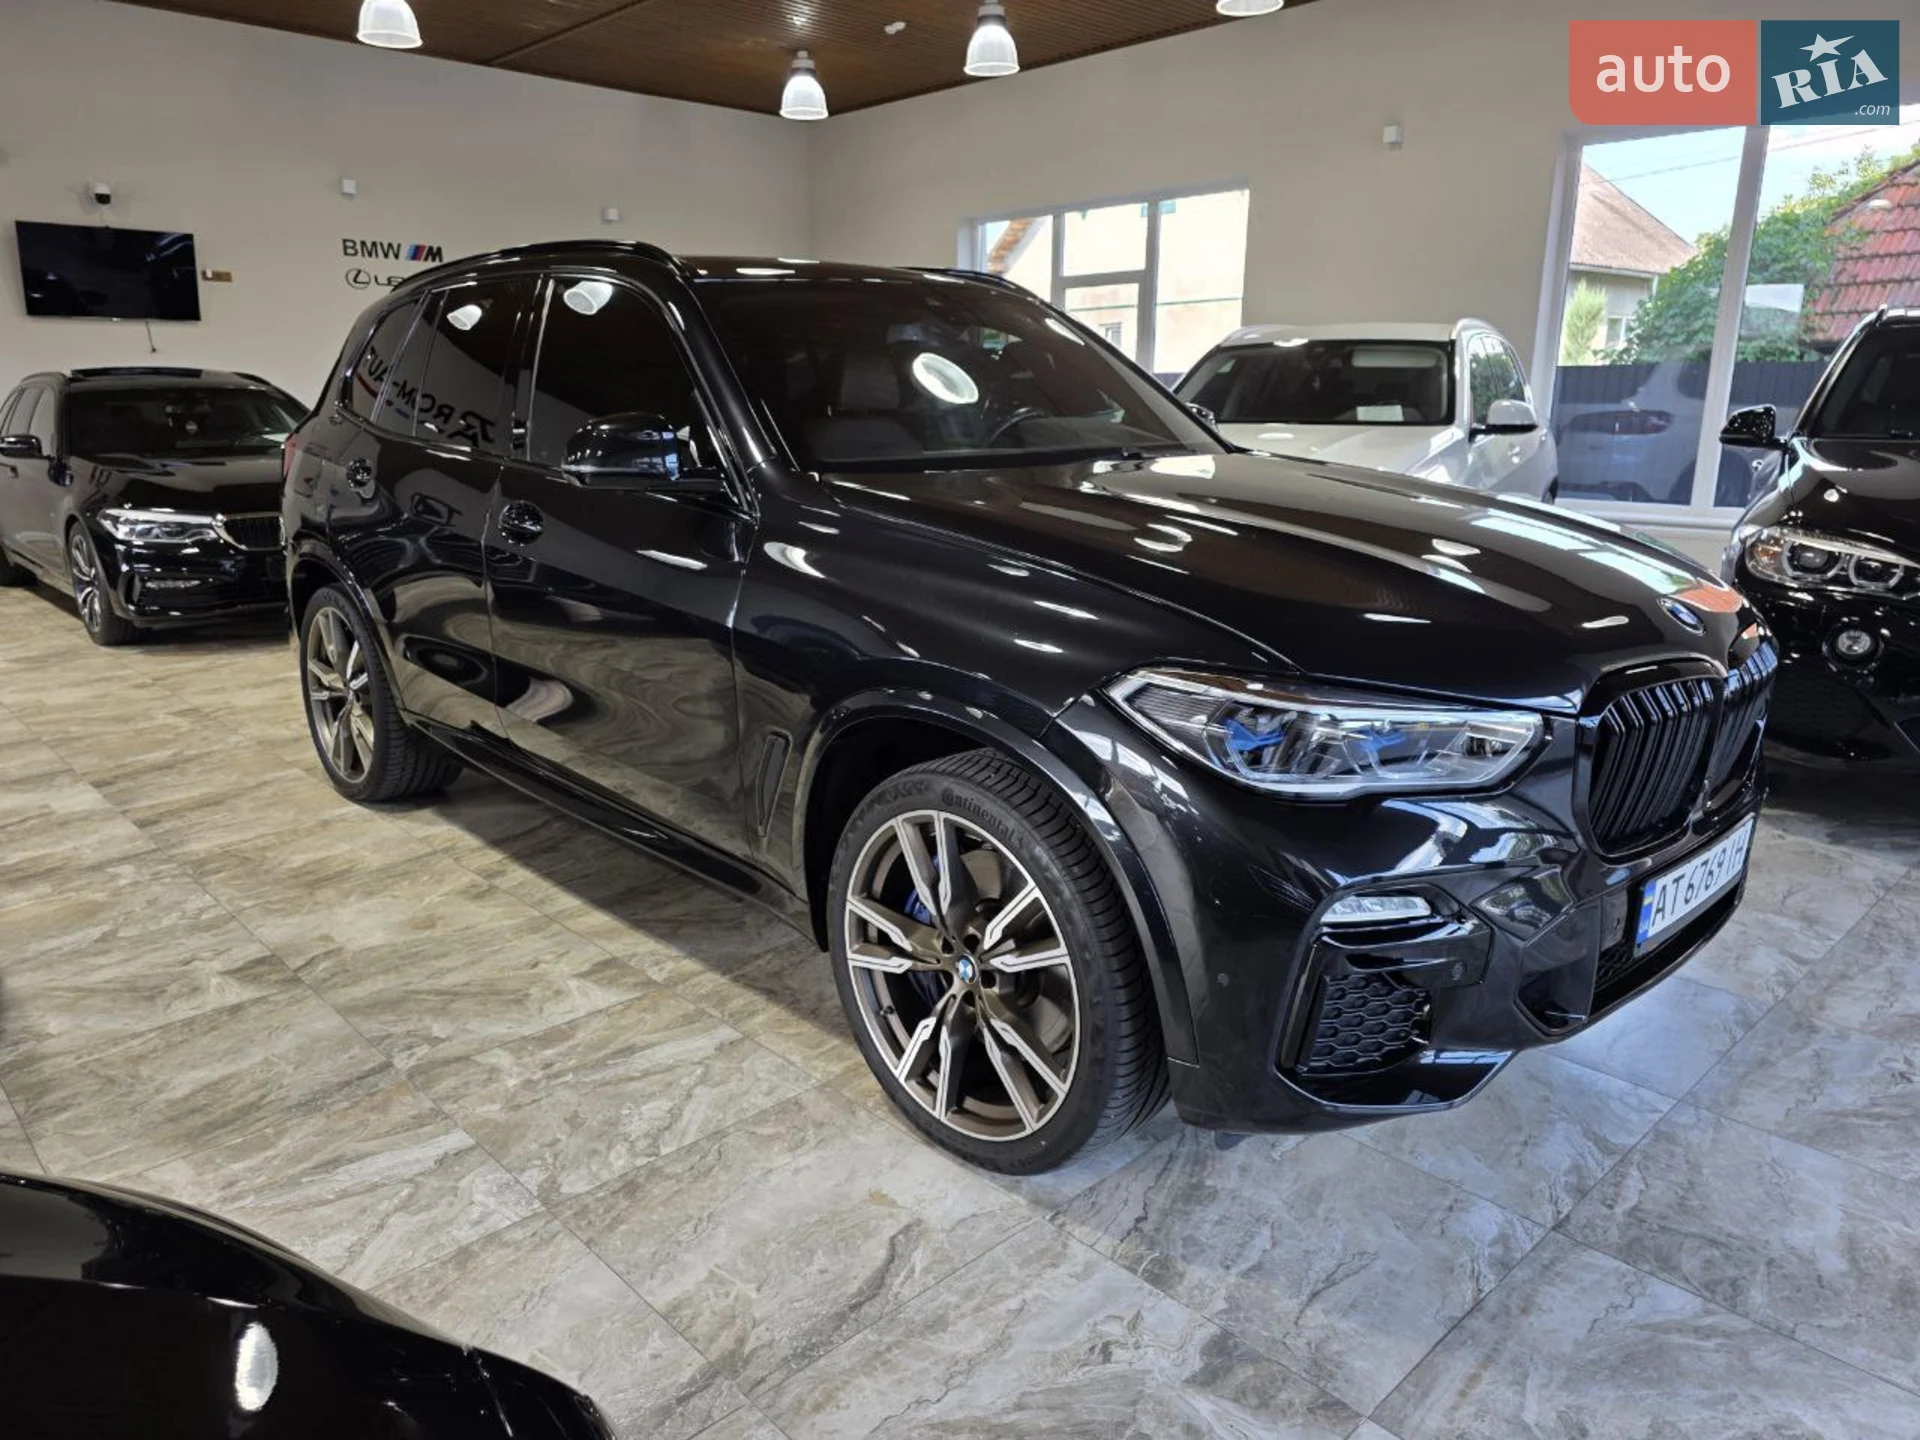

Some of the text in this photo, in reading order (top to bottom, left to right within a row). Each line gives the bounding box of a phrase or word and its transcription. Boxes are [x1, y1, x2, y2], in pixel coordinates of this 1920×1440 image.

[342, 238, 402, 260] BMW
[374, 274, 406, 287] LE
[1651, 872, 1685, 928] AT
[1684, 847, 1727, 903] 6769
